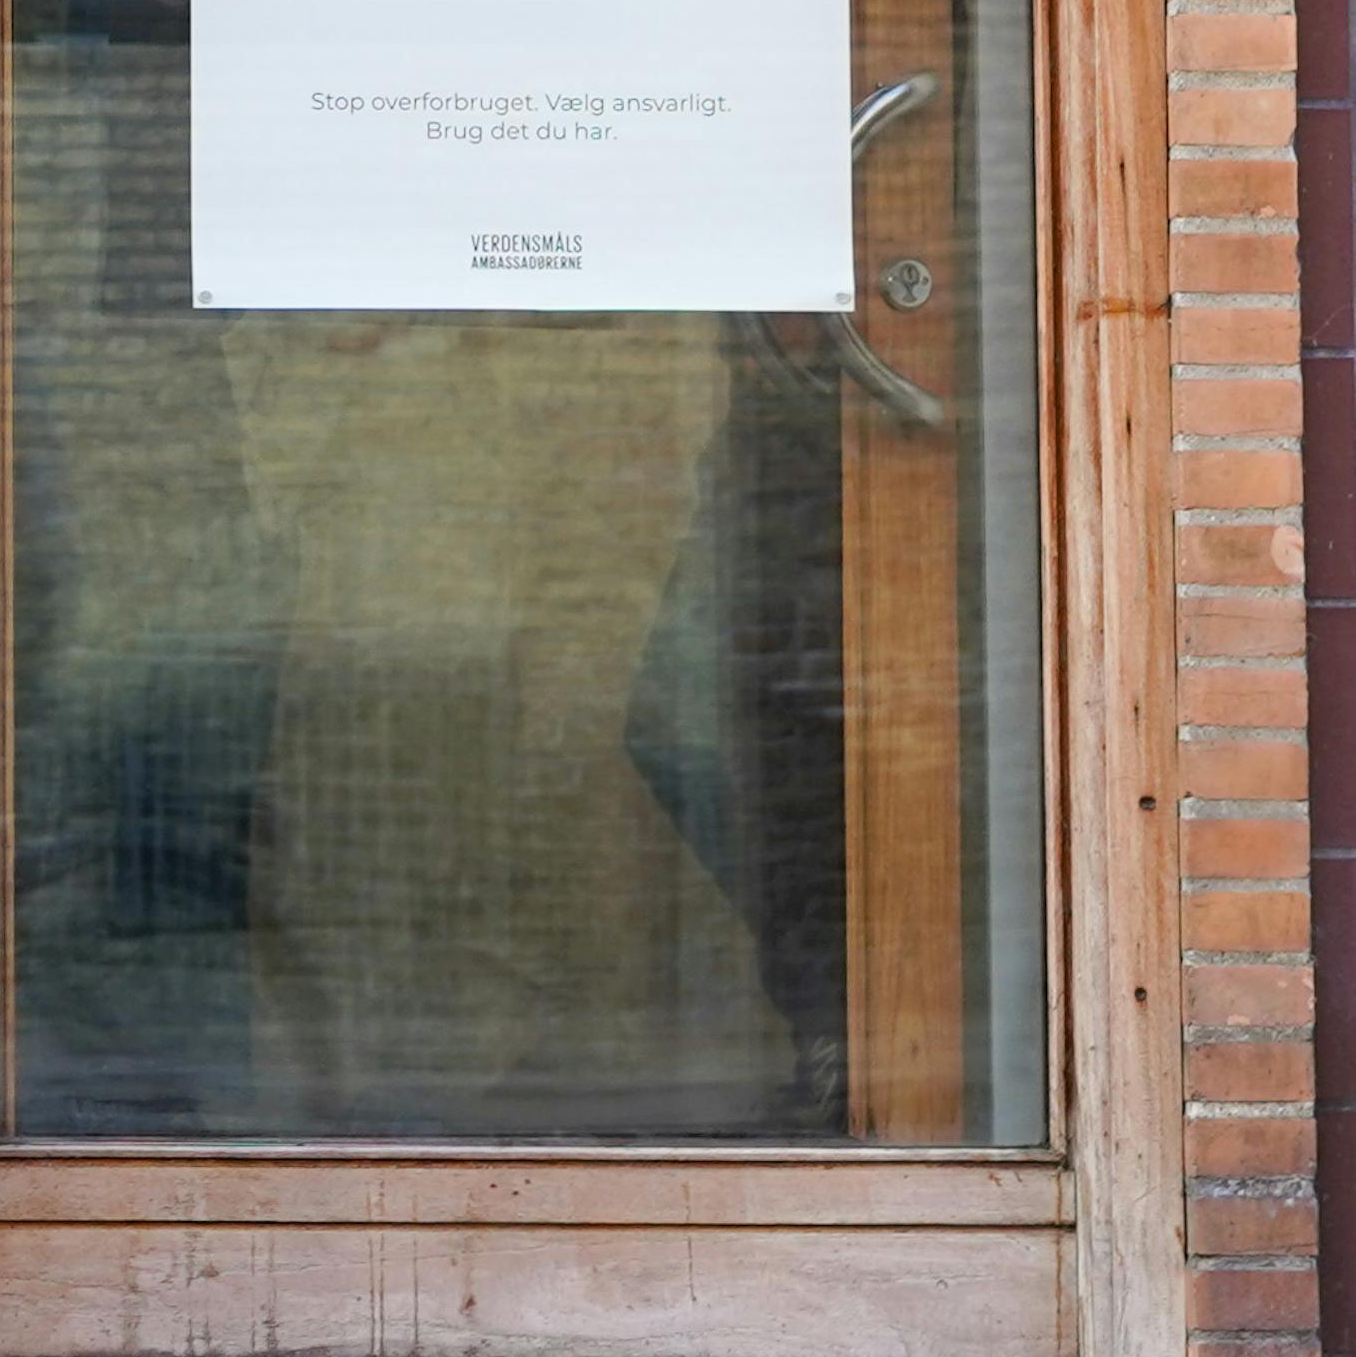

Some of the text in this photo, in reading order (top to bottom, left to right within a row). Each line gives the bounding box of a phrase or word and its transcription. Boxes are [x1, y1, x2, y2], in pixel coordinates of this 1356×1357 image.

[311, 91, 732, 118] Stop overforbruget. Vælg ansvarligt.
[427, 120, 618, 145] Brug det du har.
[471, 231, 583, 254] VERDENSMÅLS
[471, 254, 583, 270] AMBASSADØRERNE
